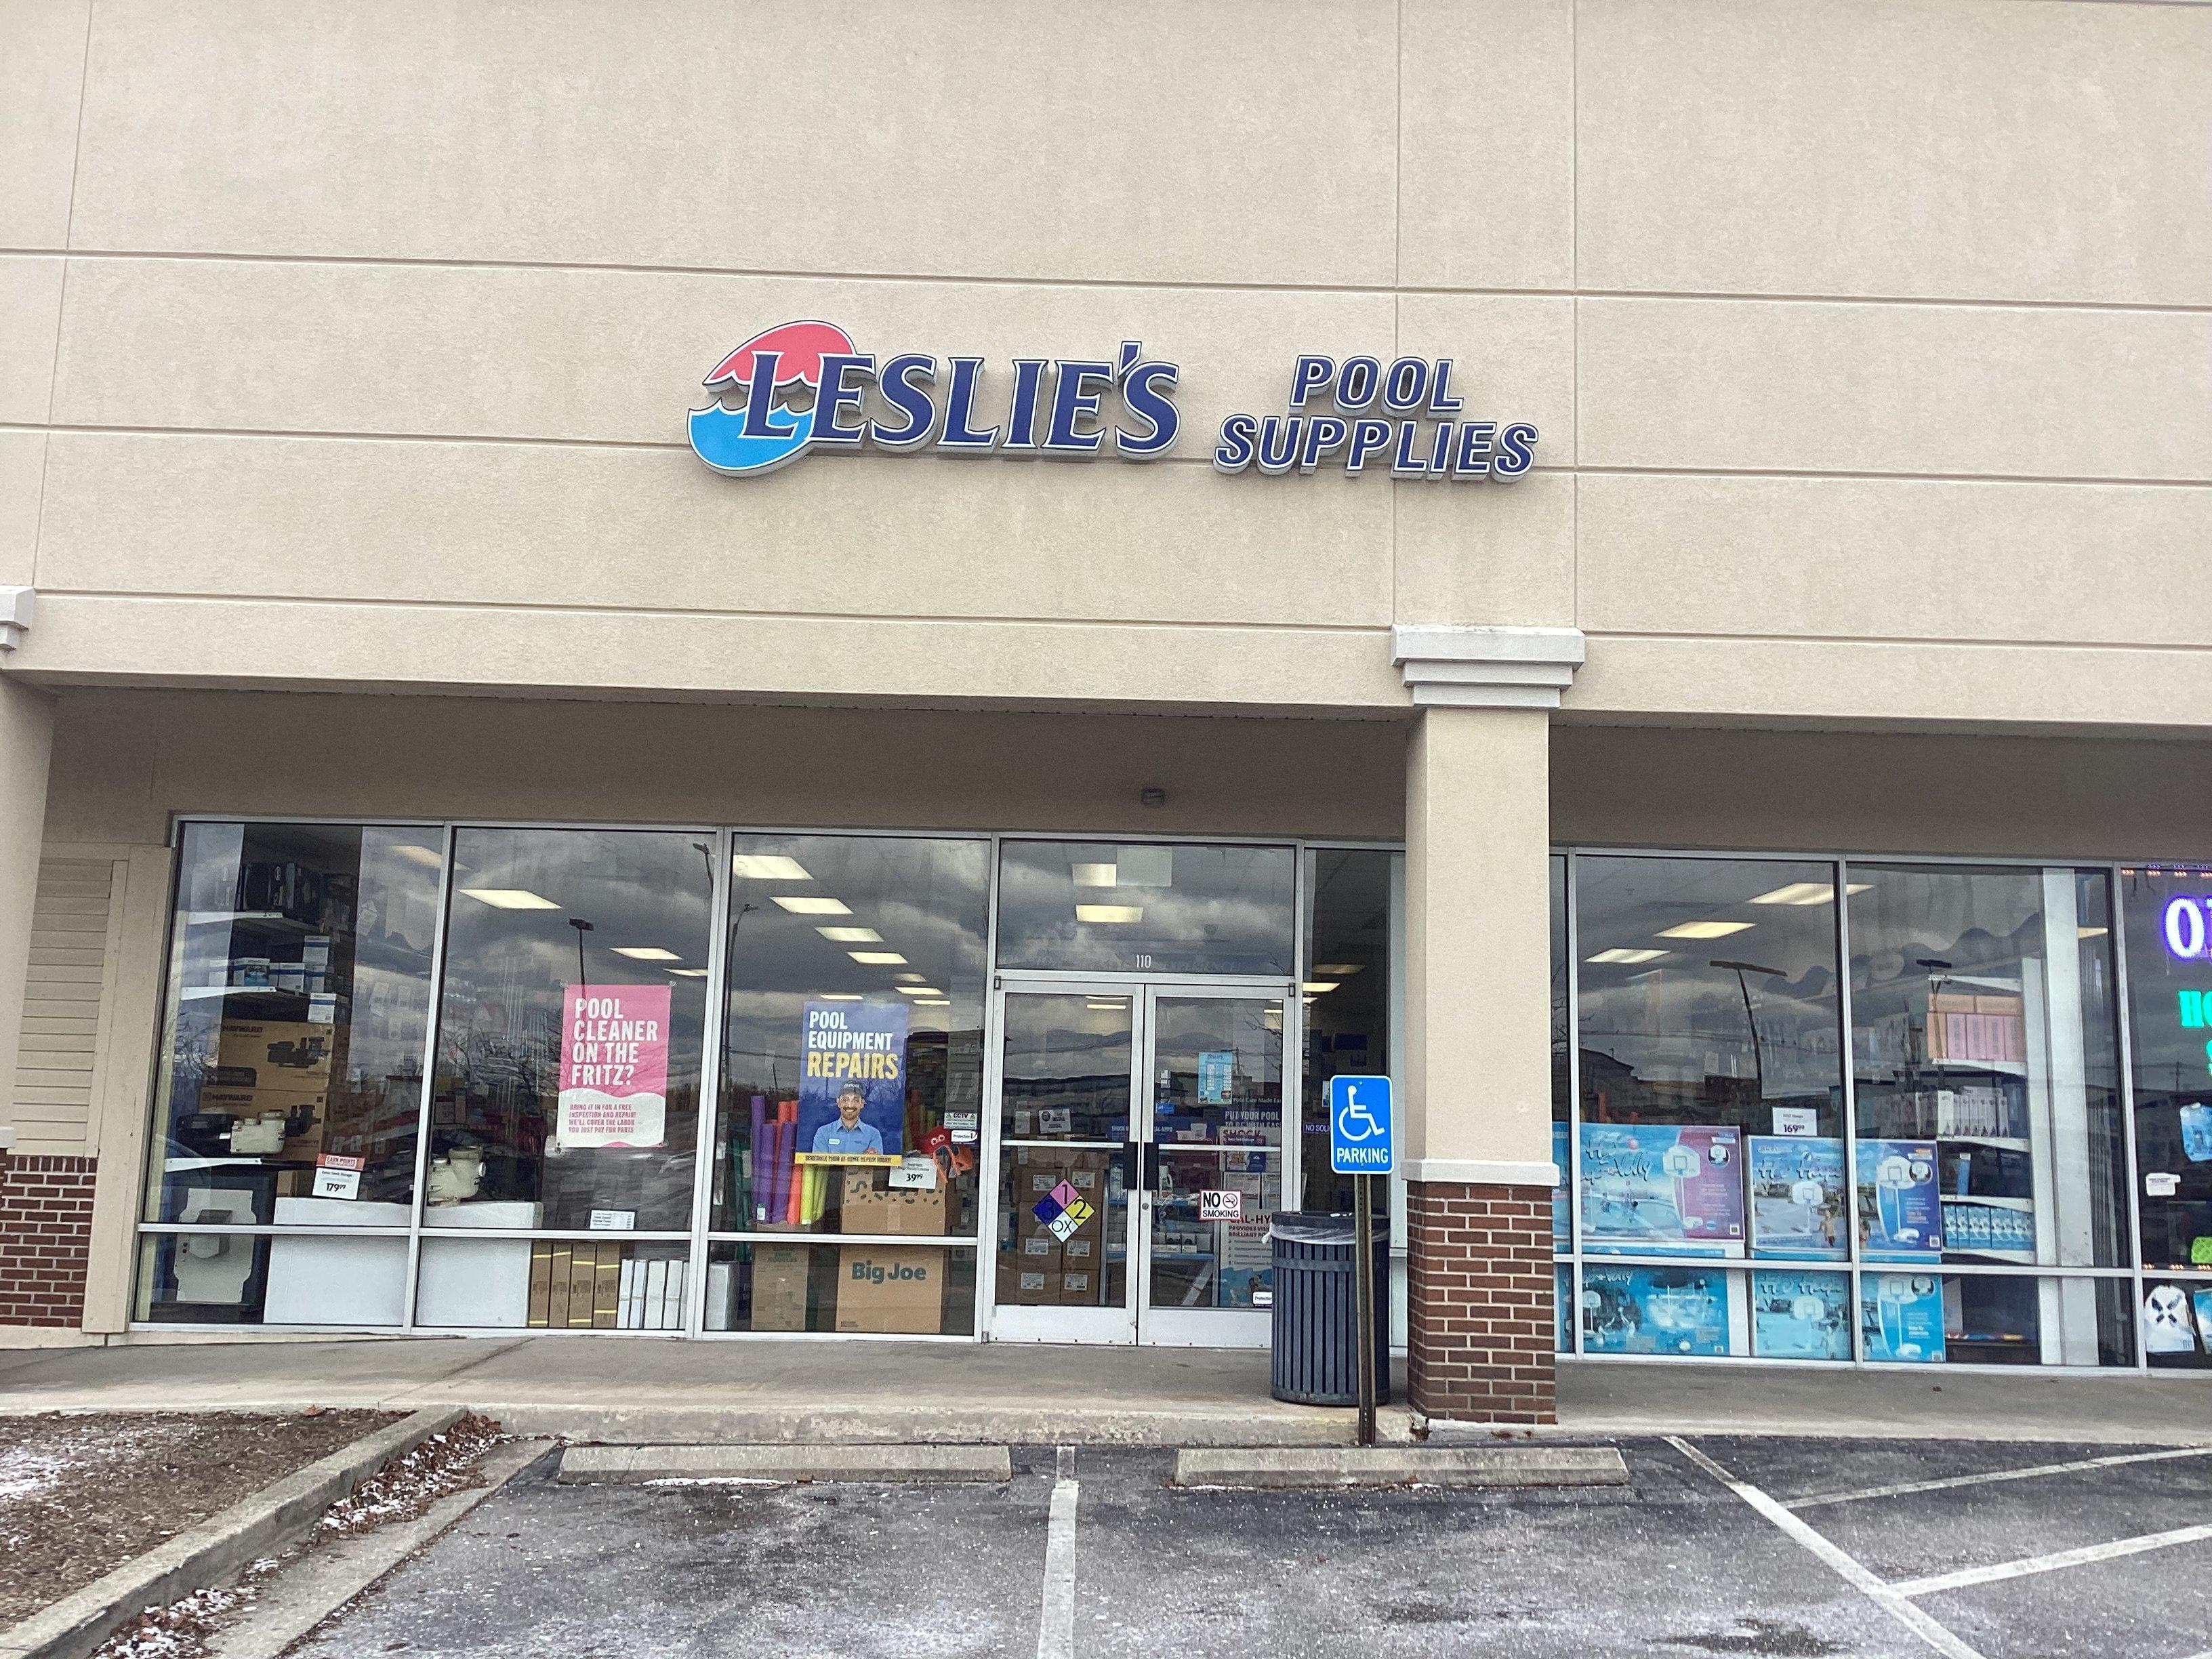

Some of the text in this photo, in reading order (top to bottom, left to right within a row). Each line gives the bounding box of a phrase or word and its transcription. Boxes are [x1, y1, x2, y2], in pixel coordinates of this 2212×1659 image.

[1288, 354, 1464, 415] POOL
[735, 340, 1182, 457] LESLIE'S
[1214, 413, 1538, 478] SUPPLIES
[1136, 954, 1151, 968] 110
[575, 998, 624, 1019] POOL
[808, 1010, 848, 1029] POOL
[573, 1020, 658, 1042] CLEANER
[808, 1031, 893, 1051] EQUIPMENT
[572, 1042, 640, 1064] ON THE
[571, 1064, 635, 1086] FRITZ?
[806, 1051, 899, 1080] REPAIRS
[211, 1094, 253, 1102] HAYWARD
[1225, 1111, 1279, 1120] PUT YOUR POOL
[1336, 1147, 1389, 1164] PARKING
[1061, 1184, 1068, 1205] 1
[1203, 1191, 1221, 1208] NO
[1073, 1198, 1086, 1220] 2
[1202, 1210, 1239, 1218] SMOKING
[1051, 1220, 1072, 1233] OX
[851, 1258, 926, 1285] Big Joe
